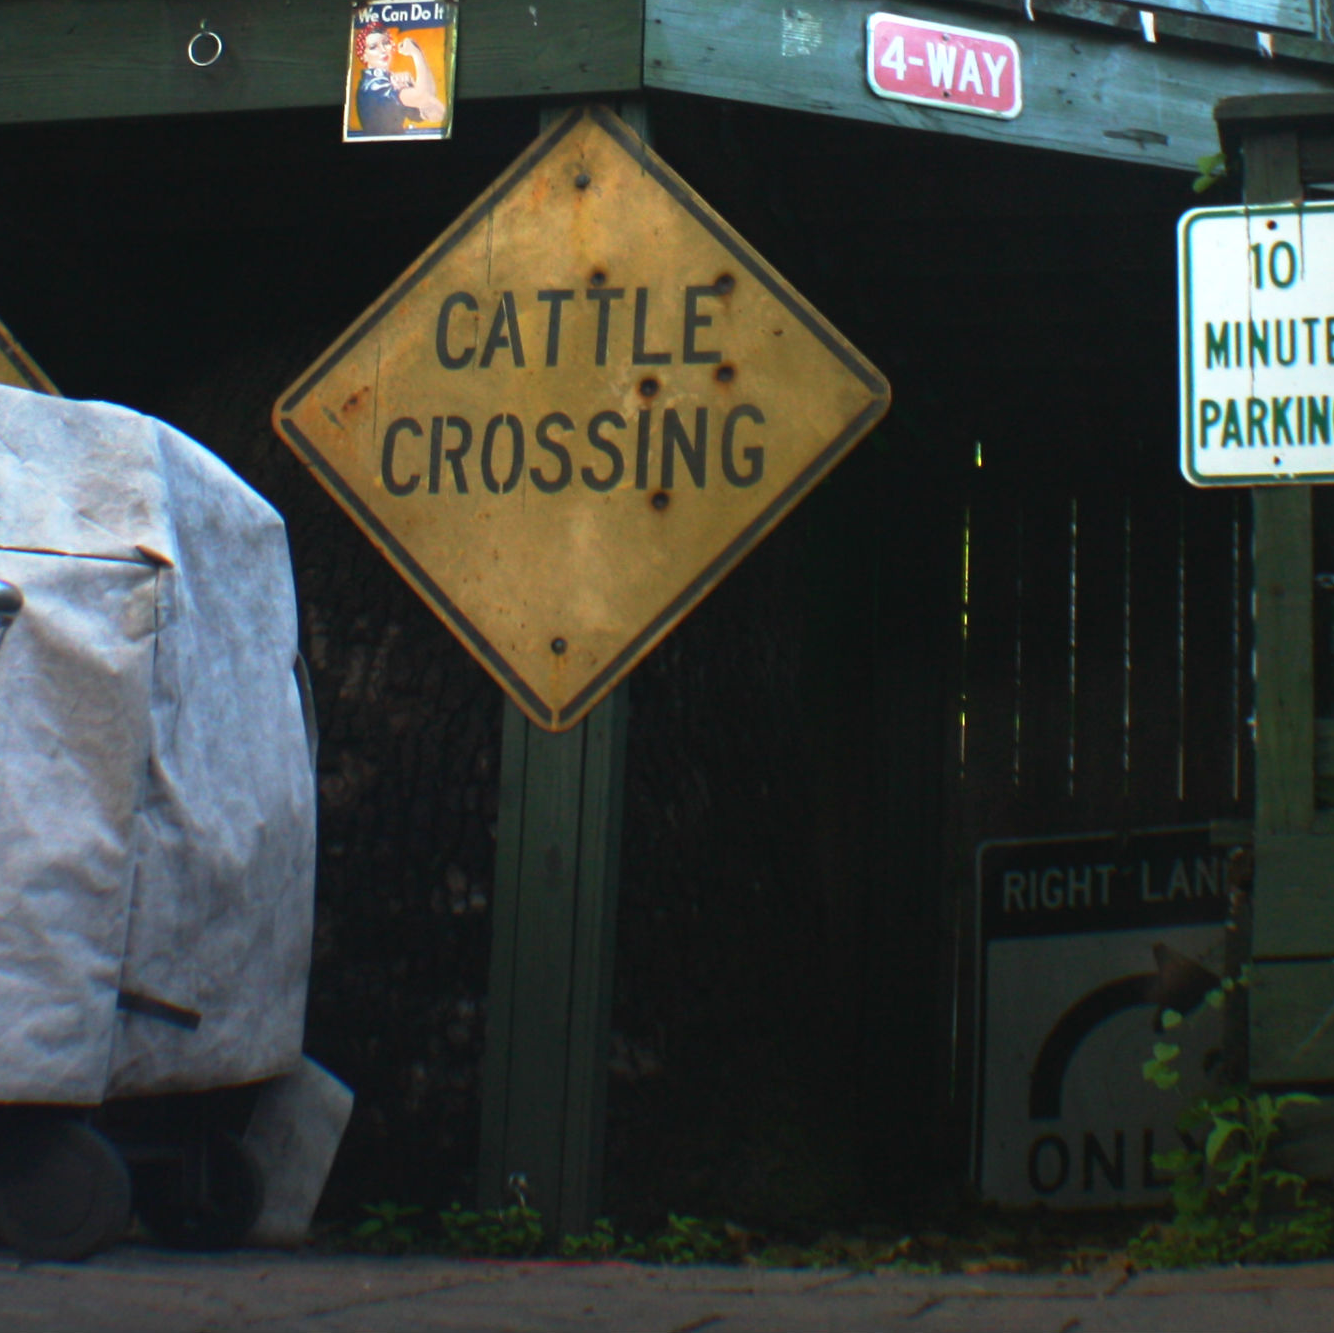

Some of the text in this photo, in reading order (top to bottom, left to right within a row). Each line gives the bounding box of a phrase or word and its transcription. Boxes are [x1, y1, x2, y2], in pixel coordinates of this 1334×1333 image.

[359, 6, 379, 24] We
[381, 5, 408, 22] Can
[410, 3, 431, 21] Do
[880, 35, 1008, 98] 4-WAY
[1250, 239, 1297, 290] 10
[435, 284, 724, 370] CATTLE
[380, 404, 767, 497] CROSSING
[1002, 854, 1230, 913] RIGHT LAN
